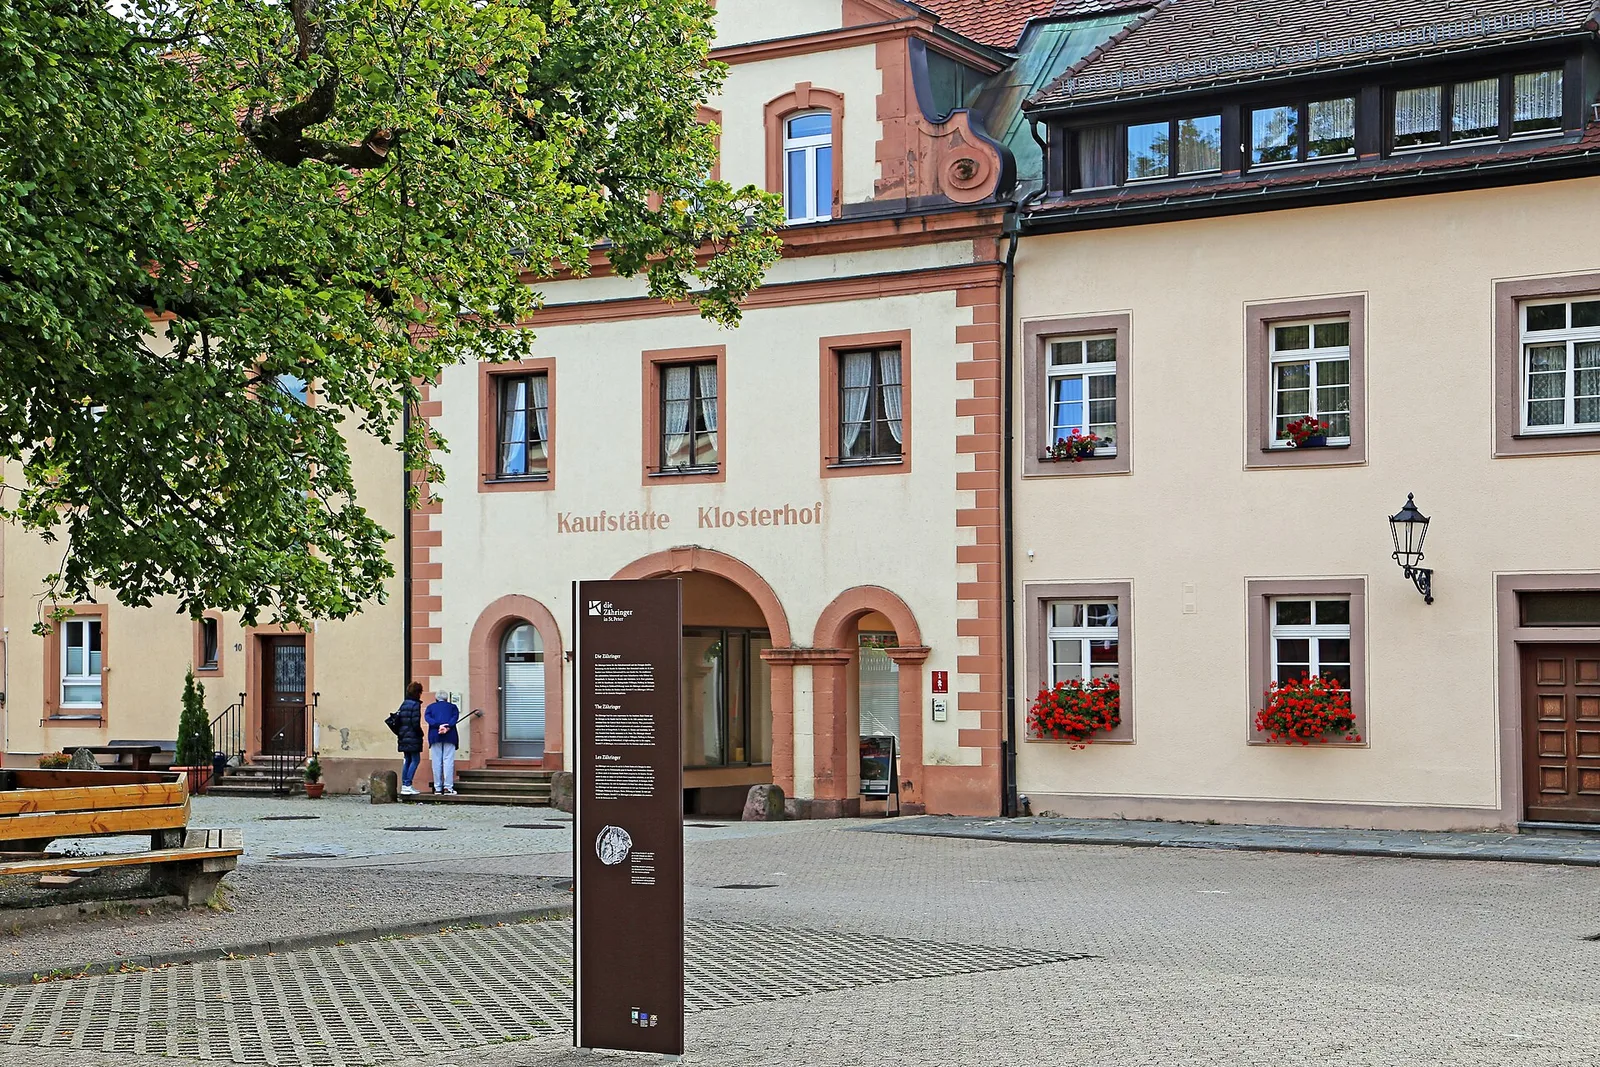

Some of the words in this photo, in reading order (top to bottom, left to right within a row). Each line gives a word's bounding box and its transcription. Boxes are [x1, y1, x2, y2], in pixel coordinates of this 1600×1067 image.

[557, 510, 670, 533] Kaufstätte
[698, 501, 822, 529] Klosterhof
[603, 609, 633, 617] Zähringer
[233, 643, 243, 652] 10
